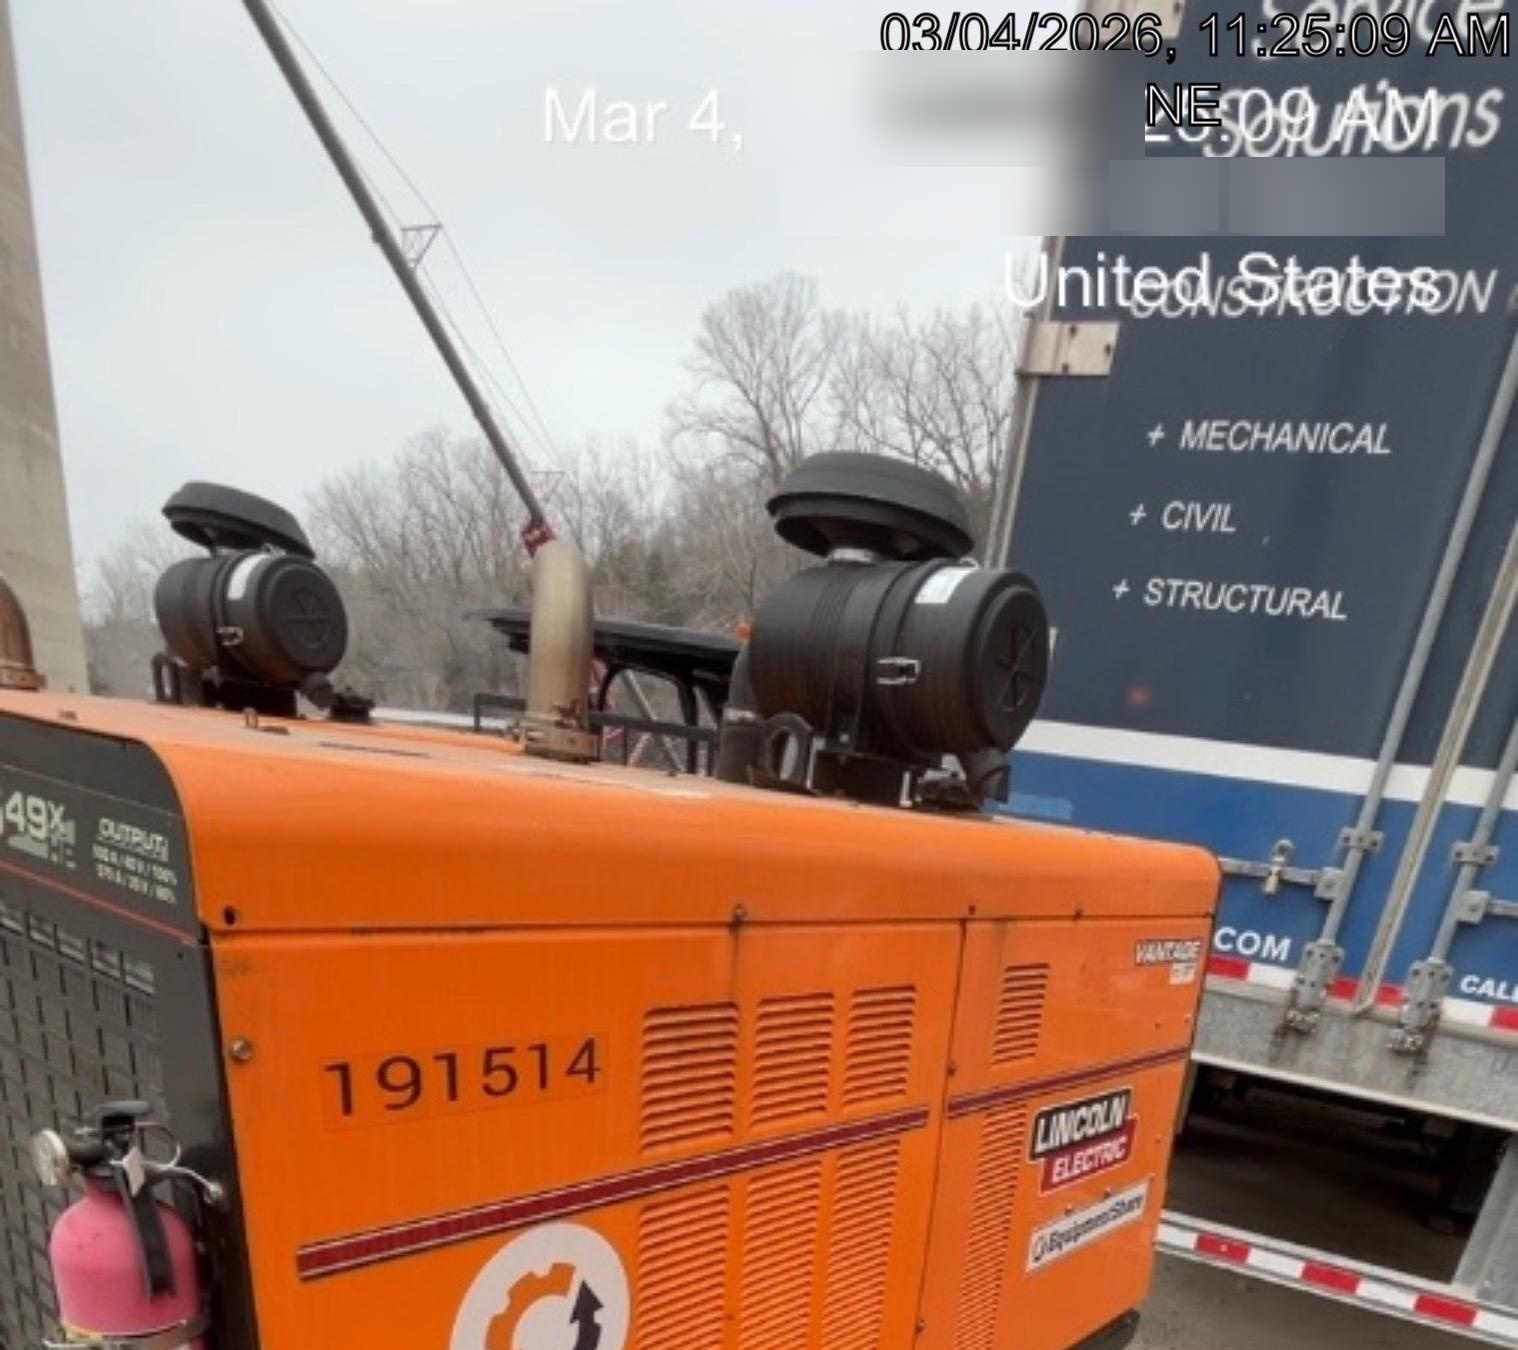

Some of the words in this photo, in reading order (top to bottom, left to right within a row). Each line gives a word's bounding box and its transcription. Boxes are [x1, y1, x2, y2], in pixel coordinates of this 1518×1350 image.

[1179, 420, 1392, 455] MECHANICAL
[1161, 500, 1236, 532] CIVIL
[1144, 578, 1348, 620] STRUCTURAL
[323, 1037, 601, 1117] 191514
[1034, 1094, 1128, 1153] LINCOLN
[1051, 1136, 1129, 1184] ELECTRIC
